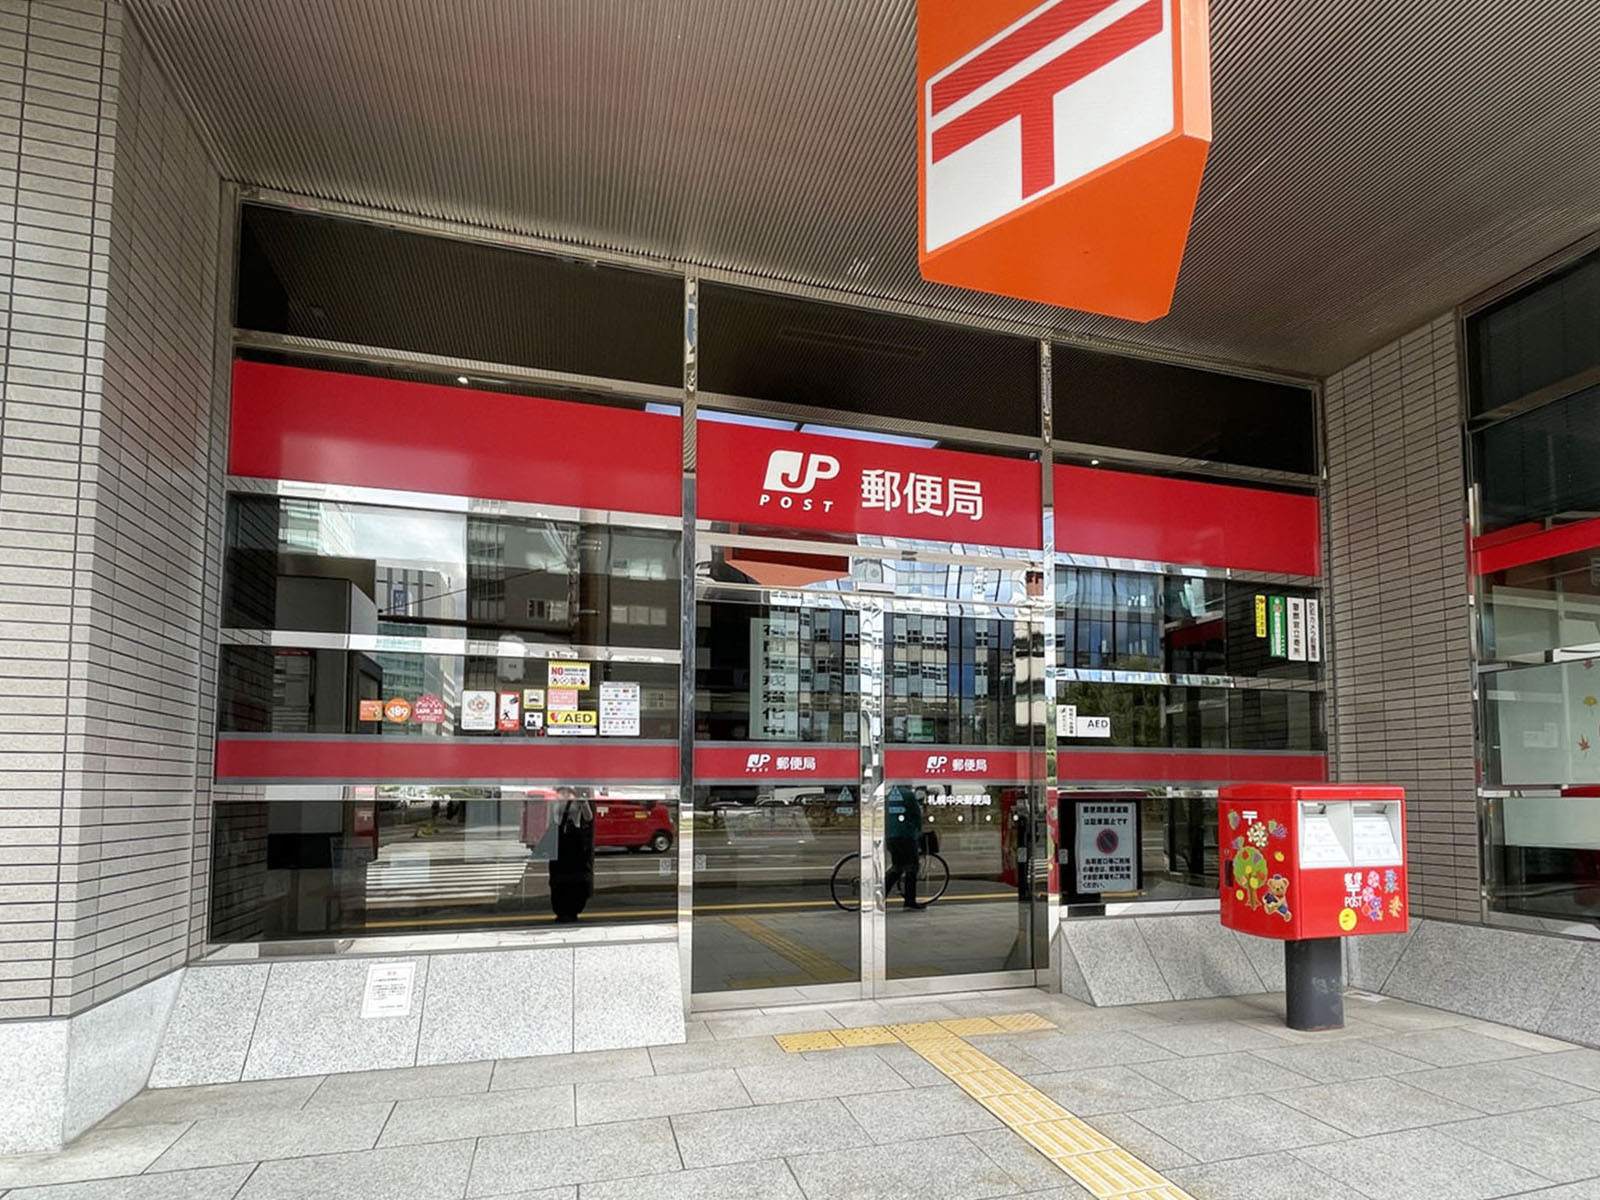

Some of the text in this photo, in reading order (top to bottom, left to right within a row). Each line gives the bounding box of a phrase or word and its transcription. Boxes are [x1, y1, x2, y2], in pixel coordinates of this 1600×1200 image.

[763, 450, 840, 494] JP
[861, 469, 984, 521] 郵便局
[759, 494, 833, 513] POST
[551, 667, 564, 676] NO
[564, 713, 592, 723] AED
[1087, 719, 1109, 729] AED
[776, 757, 816, 770] 郵便局
[951, 759, 987, 772] 郵便局
[1344, 896, 1362, 908] POST
